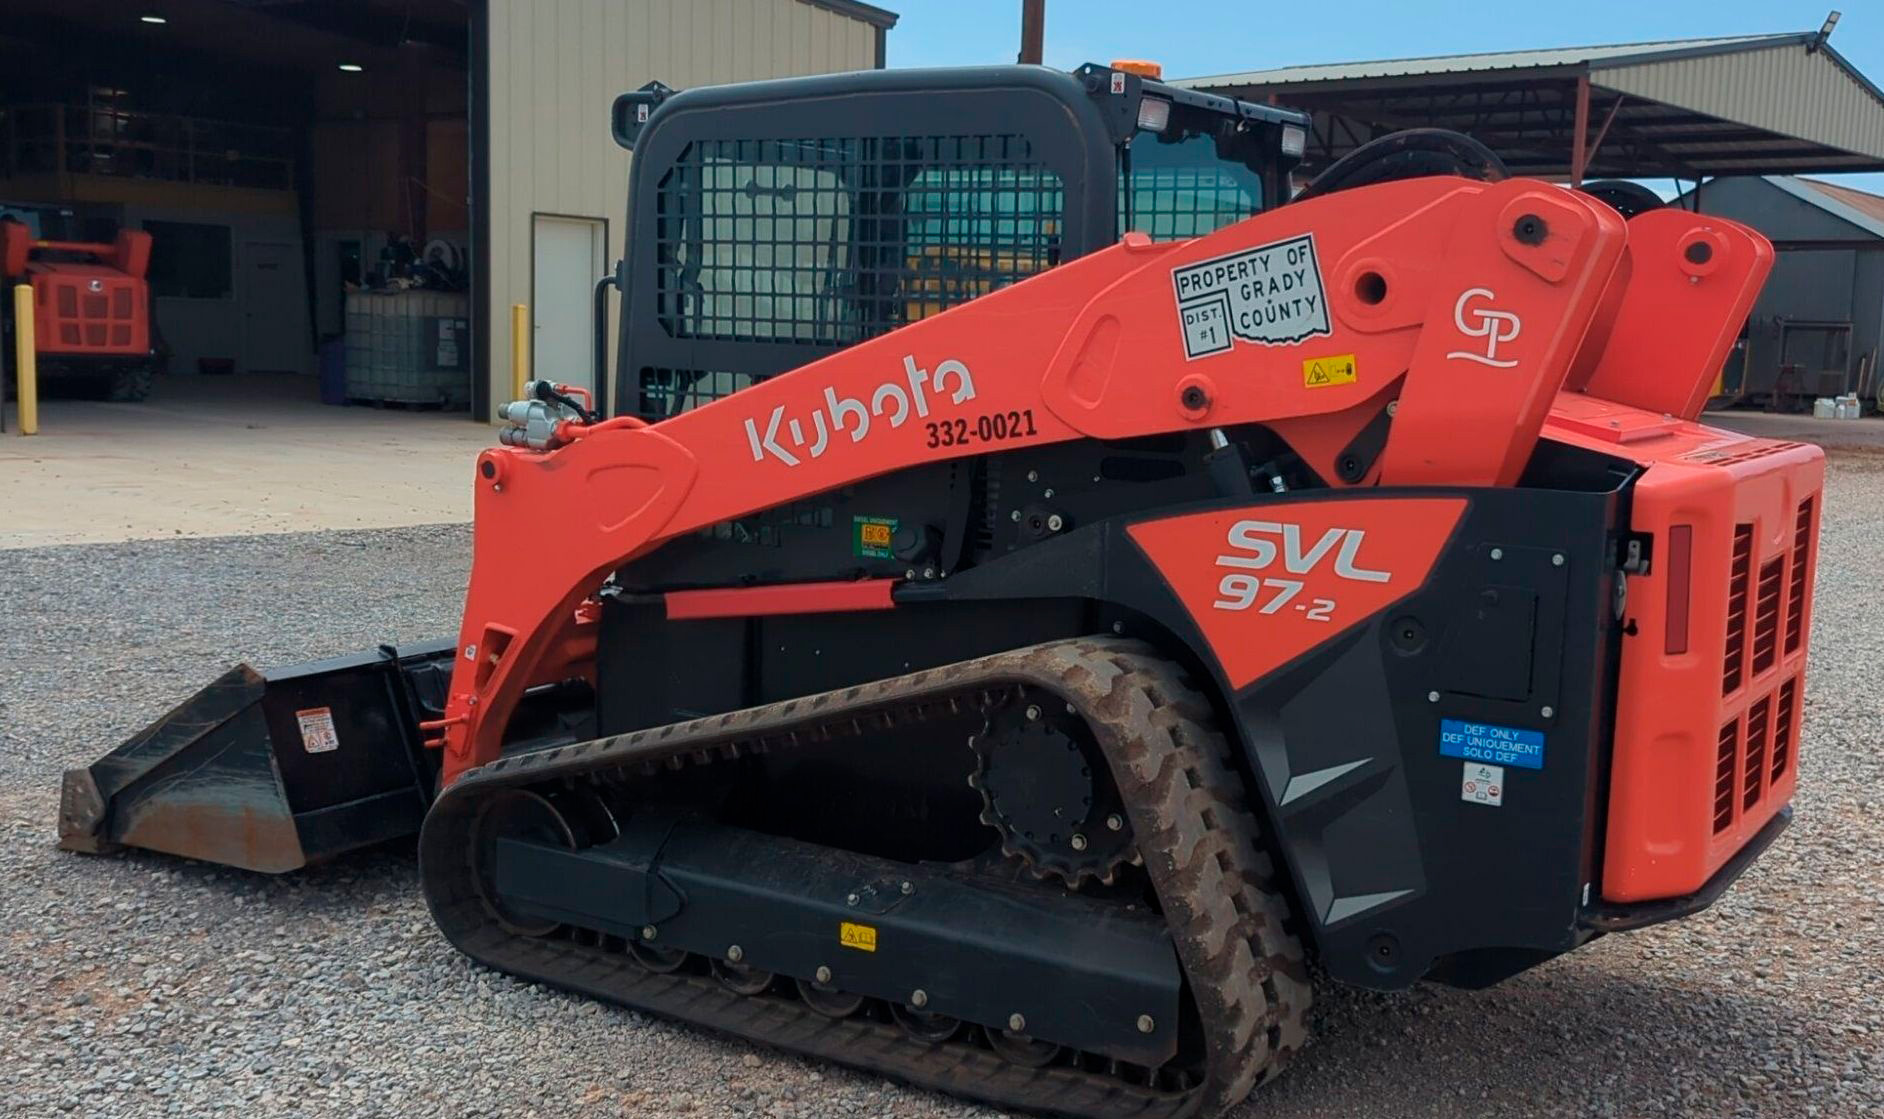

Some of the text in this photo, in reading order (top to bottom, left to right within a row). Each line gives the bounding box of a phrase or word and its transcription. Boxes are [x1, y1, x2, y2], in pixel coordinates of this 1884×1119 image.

[1180, 245, 1307, 294] PROPERTY OF
[1241, 269, 1305, 301] GRADY
[1186, 307, 1222, 325] DIST.
[1240, 295, 1317, 329] COUNTY
[1200, 326, 1216, 344] #1
[744, 355, 976, 467] Kubota
[926, 409, 1037, 449] 332-0021
[1215, 520, 1392, 583] SVL
[1213, 574, 1336, 622] 97-2
[1442, 732, 1540, 755] DEF UNIQUEMENT
[1464, 724, 1519, 741] DEF ONLY
[1463, 746, 1518, 762] SOLO DEF
